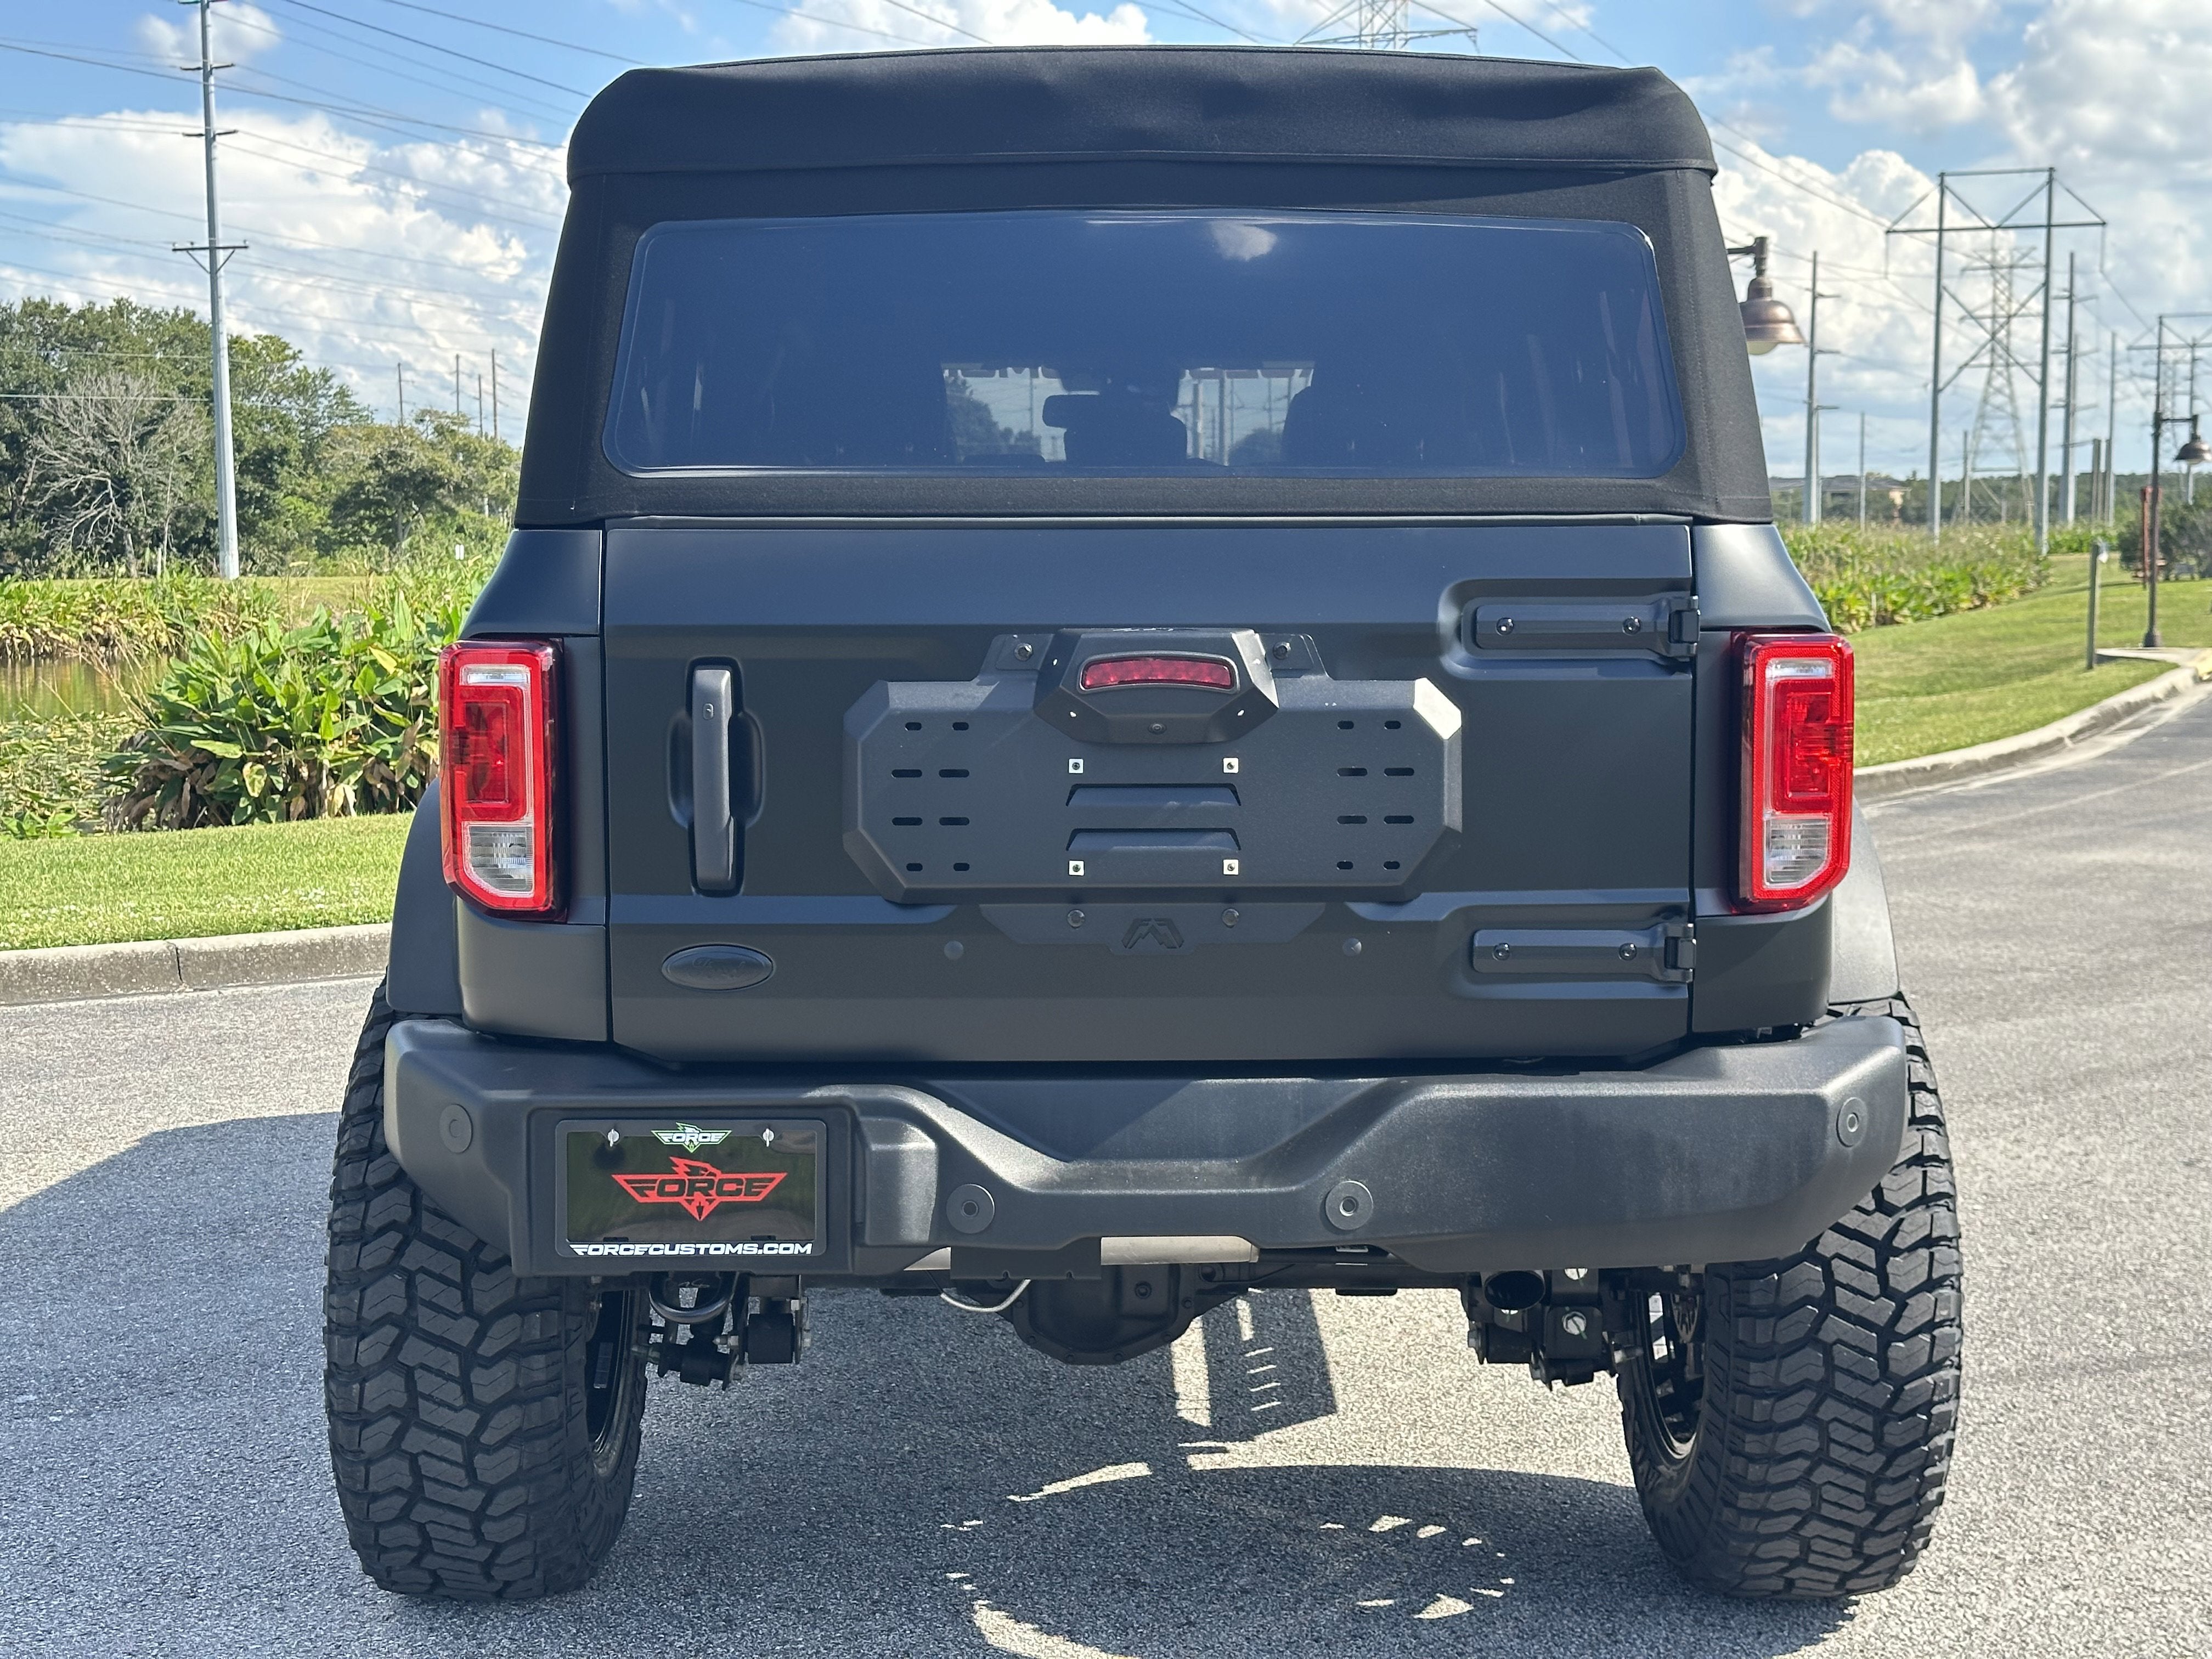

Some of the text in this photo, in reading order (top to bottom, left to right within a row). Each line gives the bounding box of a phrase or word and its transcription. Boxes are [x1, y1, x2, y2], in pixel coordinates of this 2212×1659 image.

[657, 1132, 726, 1143] FORCE
[623, 1178, 774, 1197] FORCE
[569, 1243, 812, 1256] FORCECUSTOMS.COM
